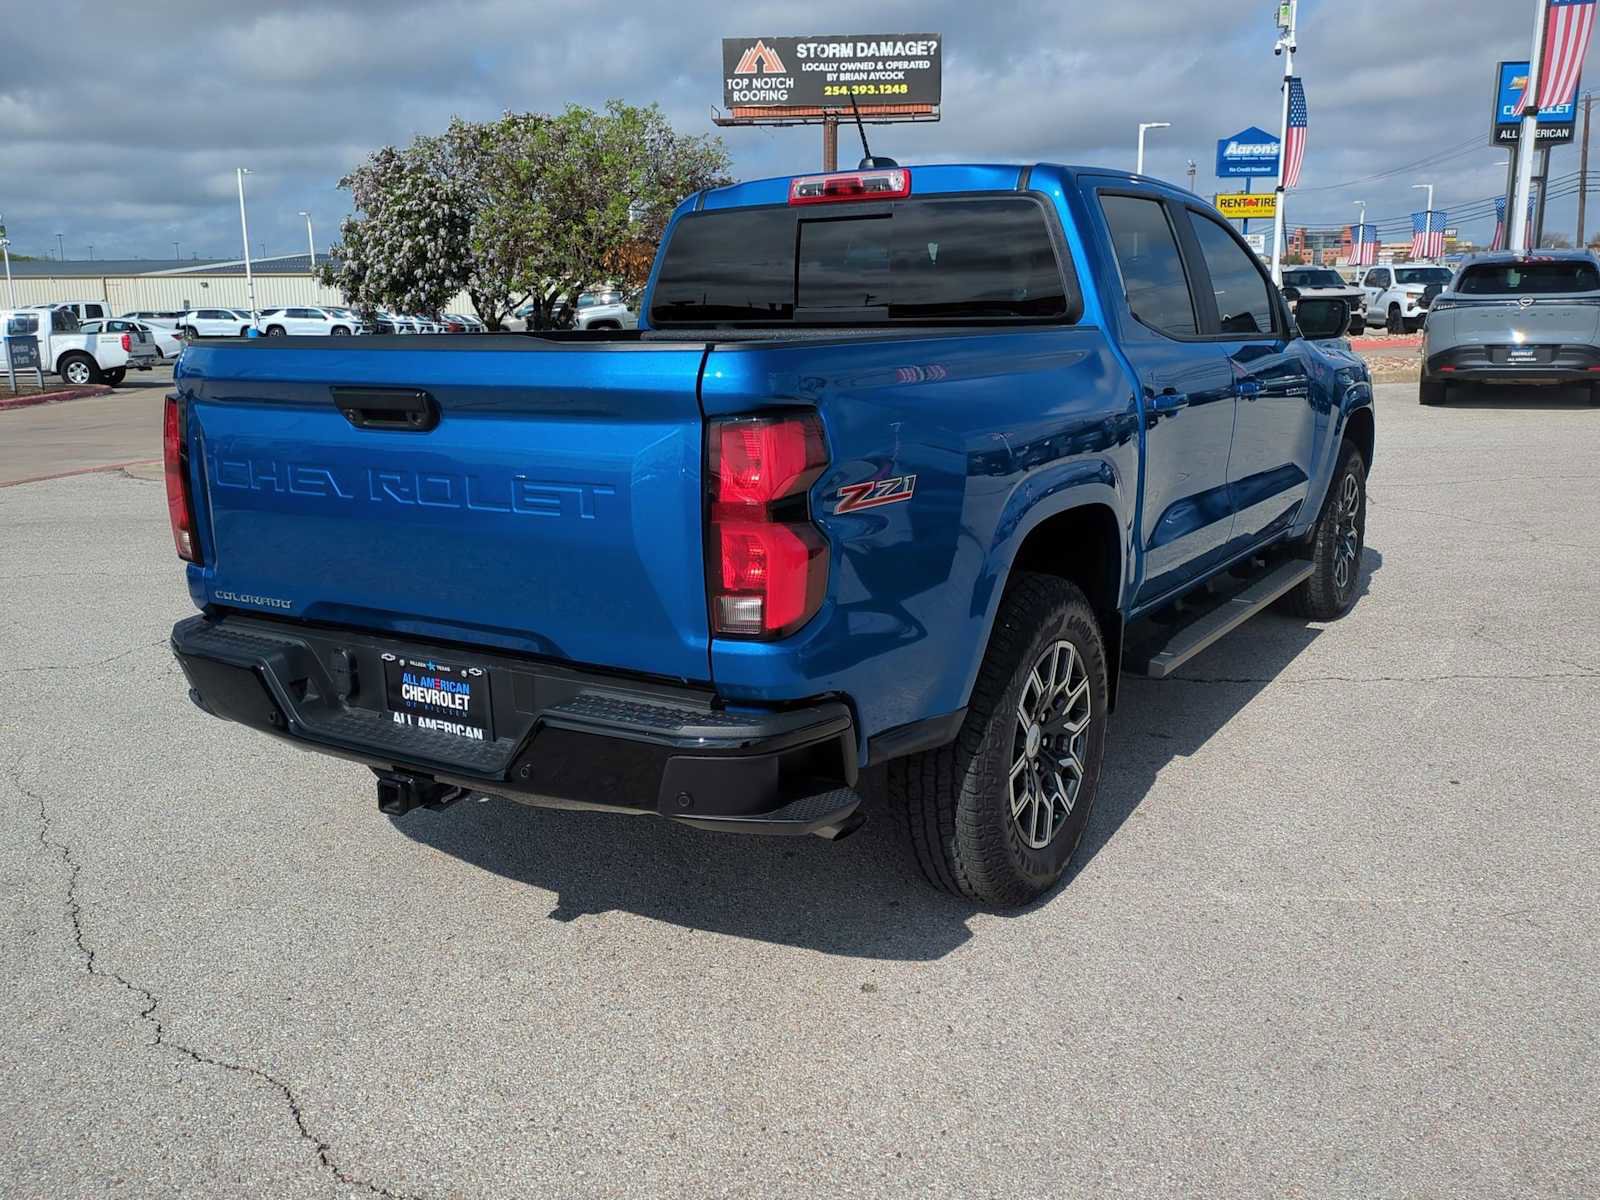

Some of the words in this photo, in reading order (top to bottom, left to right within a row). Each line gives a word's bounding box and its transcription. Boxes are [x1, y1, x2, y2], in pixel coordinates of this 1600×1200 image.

[797, 42, 853, 58] STORM
[856, 40, 938, 57] DAMAGE?
[802, 62, 838, 71] LOCALLY
[840, 61, 875, 71] OWNED
[876, 61, 884, 70] &
[885, 60, 930, 70] OPERATED
[727, 78, 750, 90] TOP
[752, 77, 794, 90] NOTCH
[827, 73, 838, 81] BY
[839, 72, 867, 81] BRIAN
[869, 71, 904, 80] AYCOCK
[733, 90, 788, 102] ROOFING
[824, 84, 908, 96] 254.393.1248
[1500, 130, 1518, 139] ALL
[1520, 129, 1569, 138] ERICAN
[1223, 141, 1280, 156] Aaron's
[1220, 198, 1247, 208] RENT
[1255, 197, 1277, 207] TIRE
[214, 458, 616, 520] CHEVROLET
[833, 474, 917, 515] Z71
[215, 590, 291, 608] COLORADO
[403, 672, 419, 686] ALL
[420, 676, 470, 694] AMERICAN
[401, 684, 470, 710] CHEVROLET
[418, 716, 483, 740] AMERICAN
